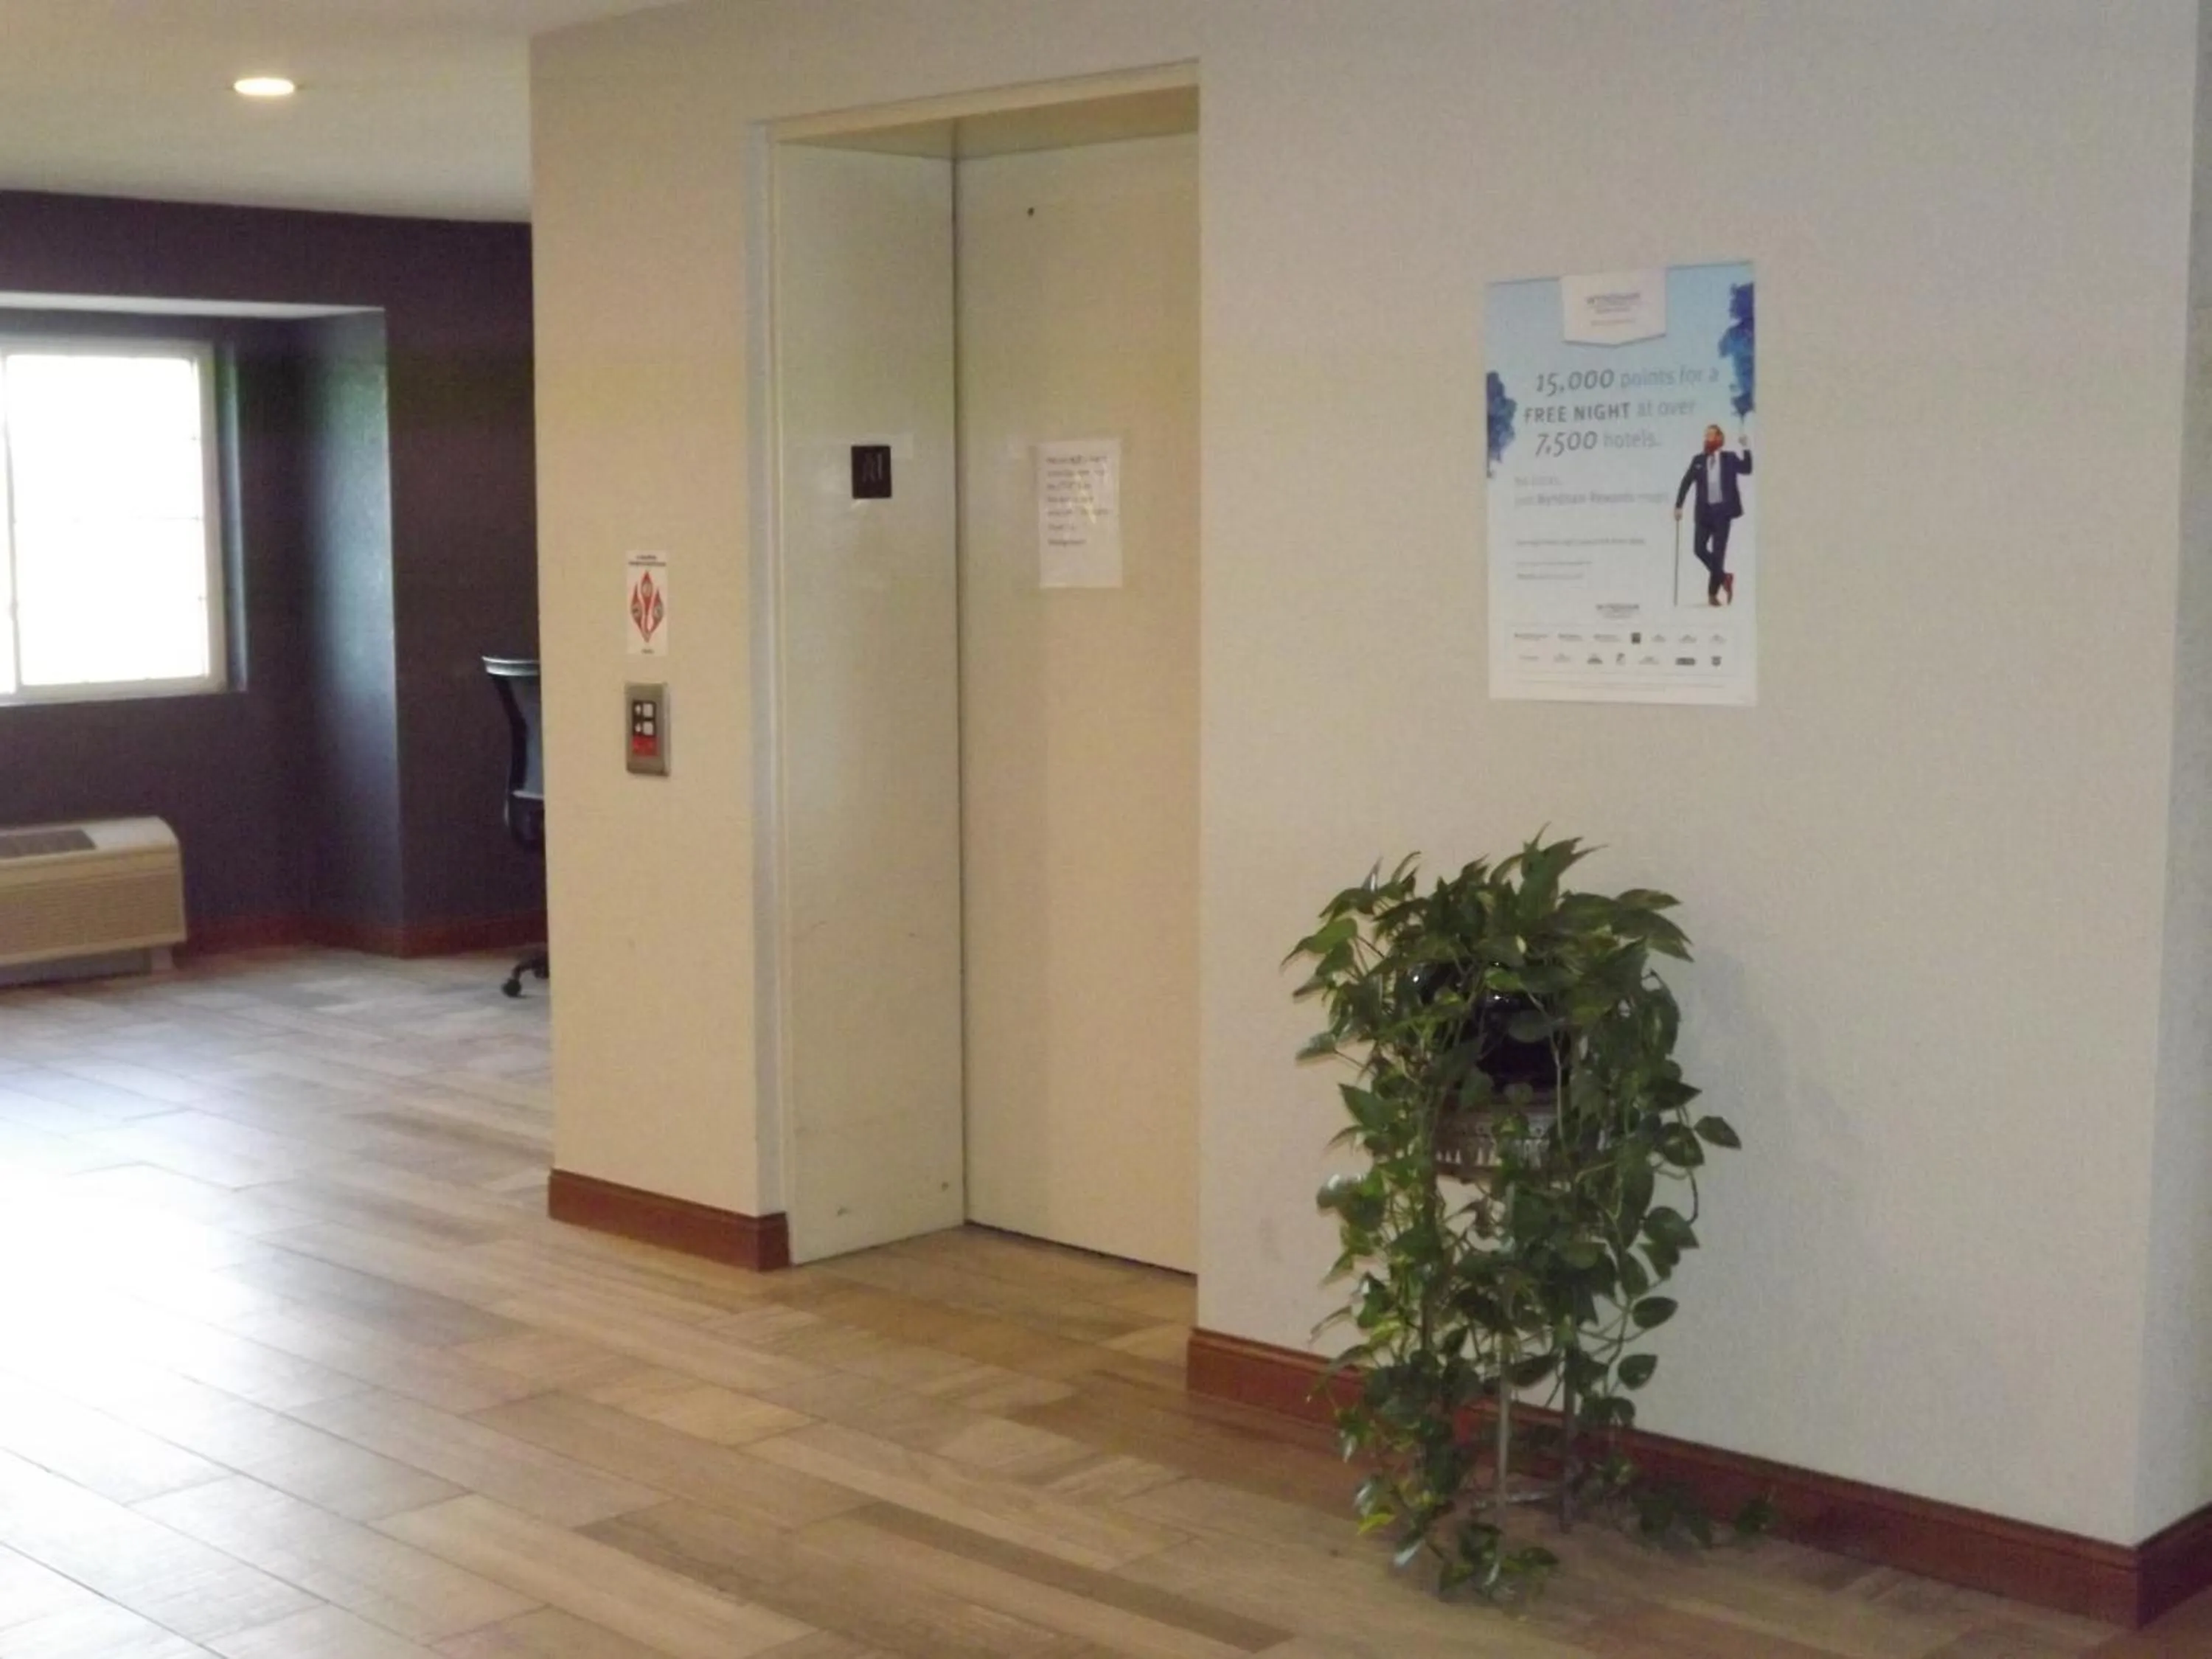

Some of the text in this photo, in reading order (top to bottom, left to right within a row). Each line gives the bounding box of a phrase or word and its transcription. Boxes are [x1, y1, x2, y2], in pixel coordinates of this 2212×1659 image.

[1536, 369, 1719, 397] 15,000 points for a
[1523, 401, 1696, 423] FREE NIGHT at over
[1535, 431, 1598, 457] 7,500
